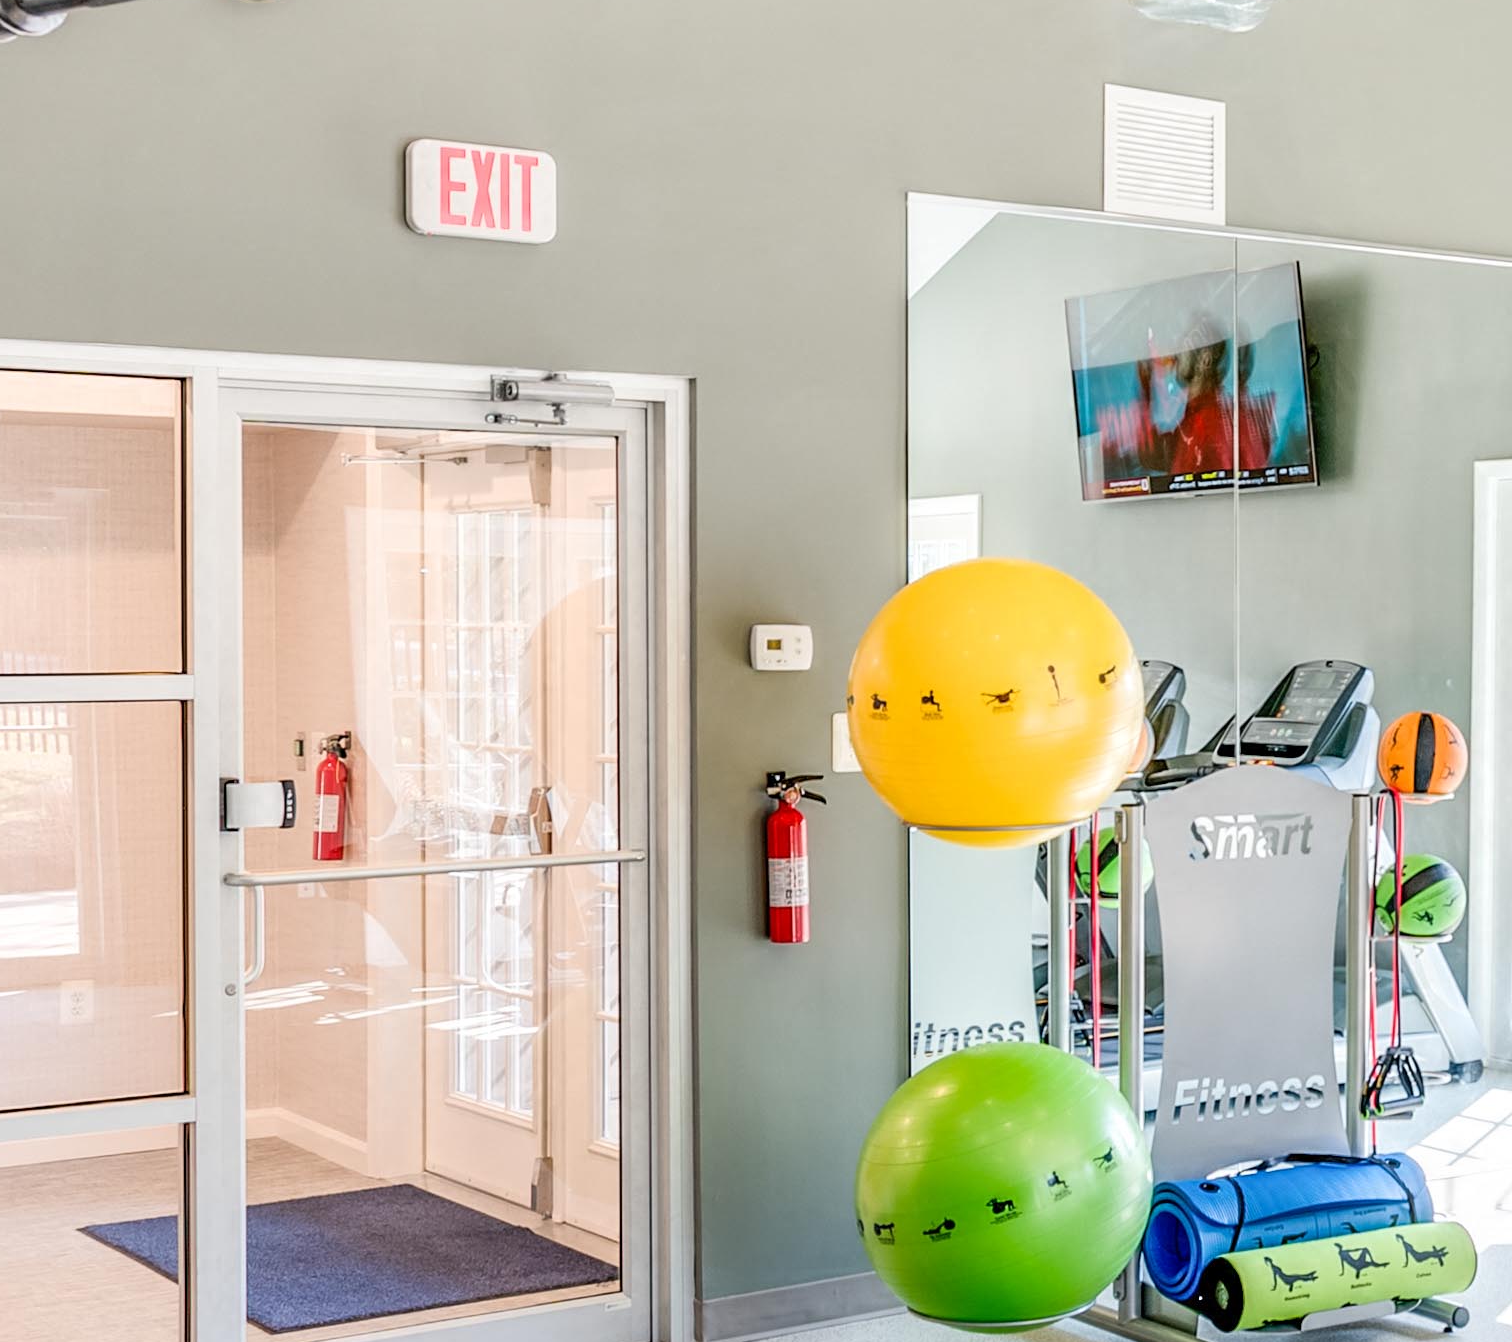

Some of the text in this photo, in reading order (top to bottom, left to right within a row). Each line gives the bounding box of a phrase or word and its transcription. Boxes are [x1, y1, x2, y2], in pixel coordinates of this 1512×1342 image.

[439, 146, 538, 232] EXIT
[1189, 816, 1313, 860] Smart
[912, 1020, 1025, 1058] itness
[1172, 1074, 1325, 1125] Fitness
